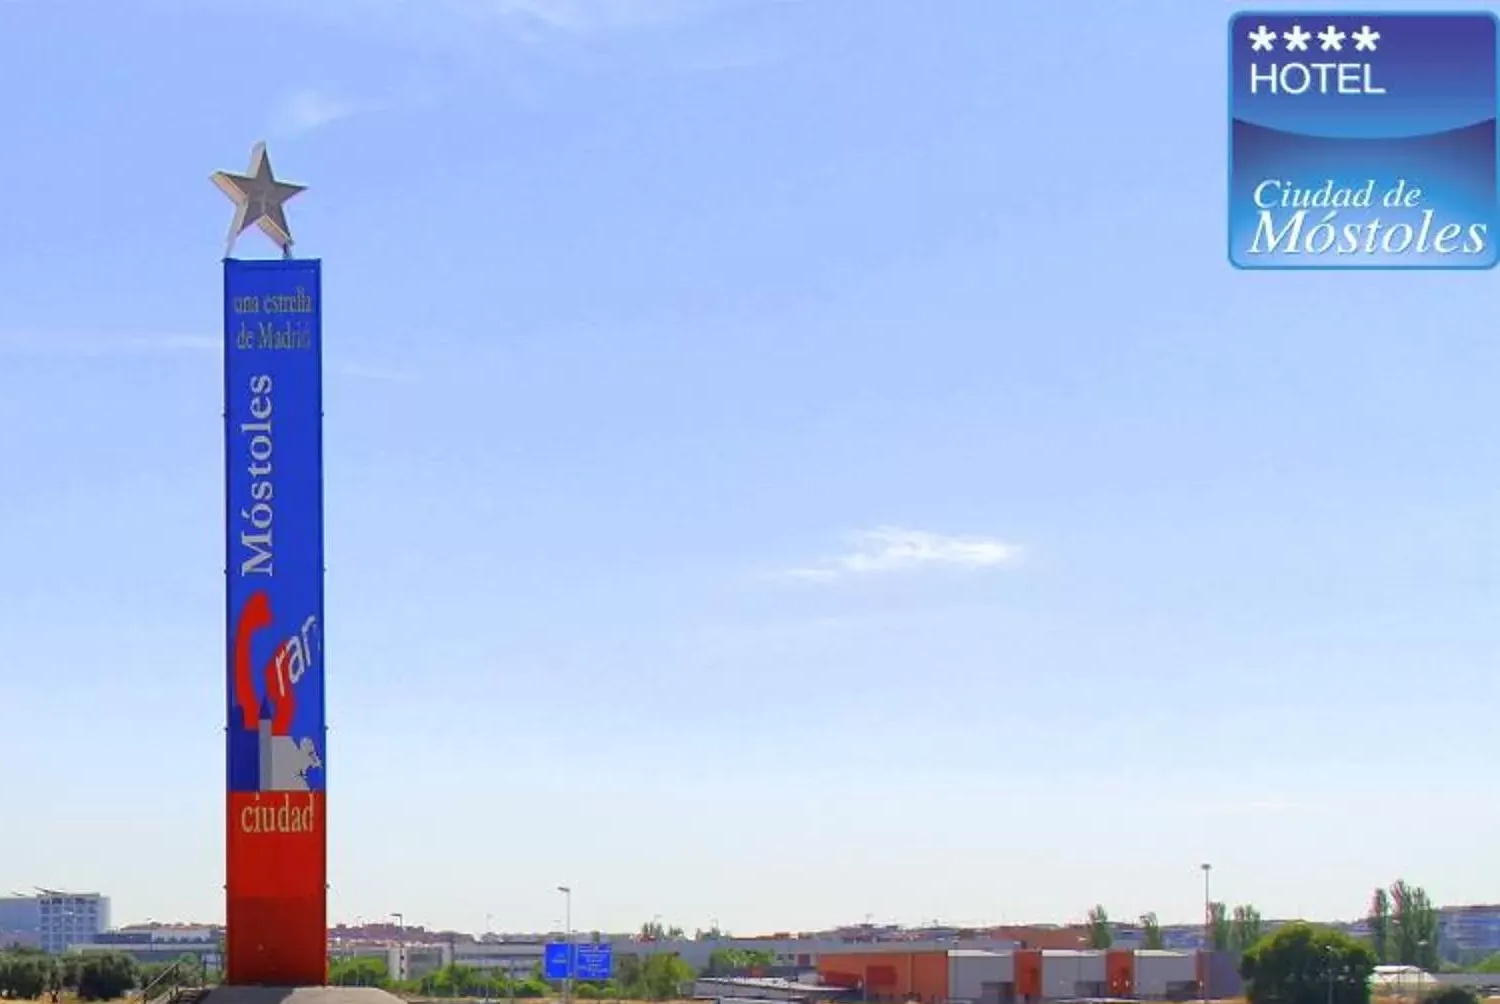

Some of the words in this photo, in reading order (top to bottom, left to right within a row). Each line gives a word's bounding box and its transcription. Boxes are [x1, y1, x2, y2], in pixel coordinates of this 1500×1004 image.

[237, 321, 253, 349] de
[241, 374, 273, 577] Móstoles
[241, 793, 316, 834] ciudad
